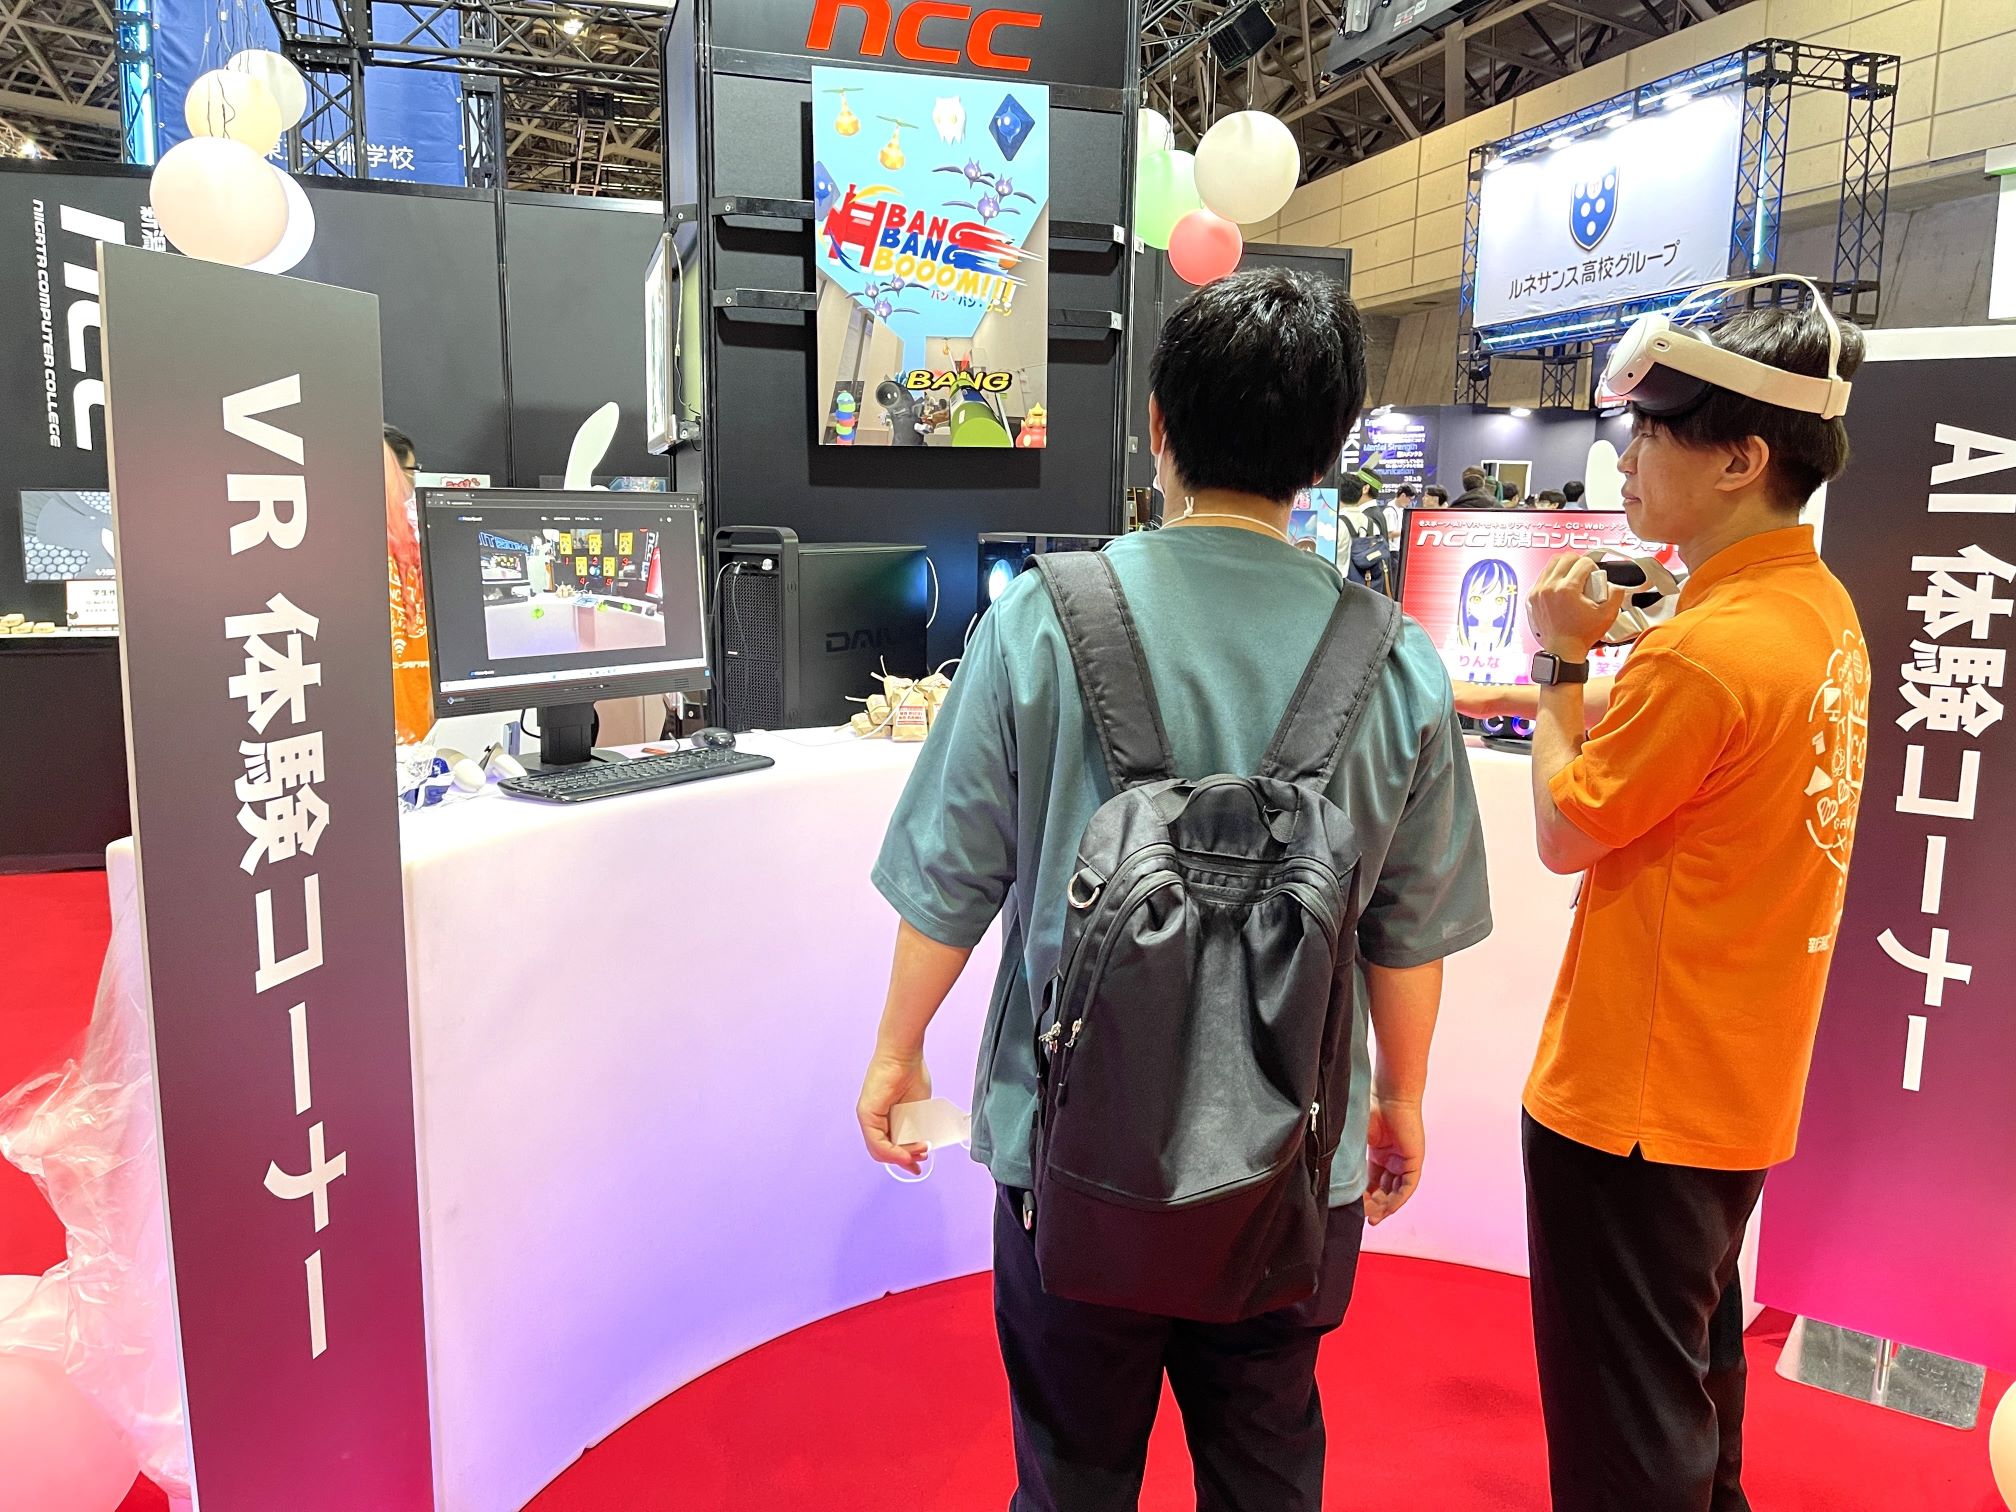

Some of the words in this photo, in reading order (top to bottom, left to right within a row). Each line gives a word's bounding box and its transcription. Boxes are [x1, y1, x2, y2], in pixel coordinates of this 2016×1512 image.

[806, 0, 1042, 72] ncc
[32, 199, 49, 269] NIIGATA
[879, 227, 1008, 274] BANG
[885, 203, 1020, 258] BANG
[1508, 239, 1682, 300] ルネサンス高校グループ
[37, 269, 56, 368] COMPUTER
[44, 368, 62, 448] COLLEGE
[222, 373, 308, 556] VR
[1927, 422, 2016, 514] AI
[1459, 655, 1500, 669] りんな
[1877, 543, 2016, 1092] 体験コーナー
[224, 592, 347, 1360] 体験コーナー
